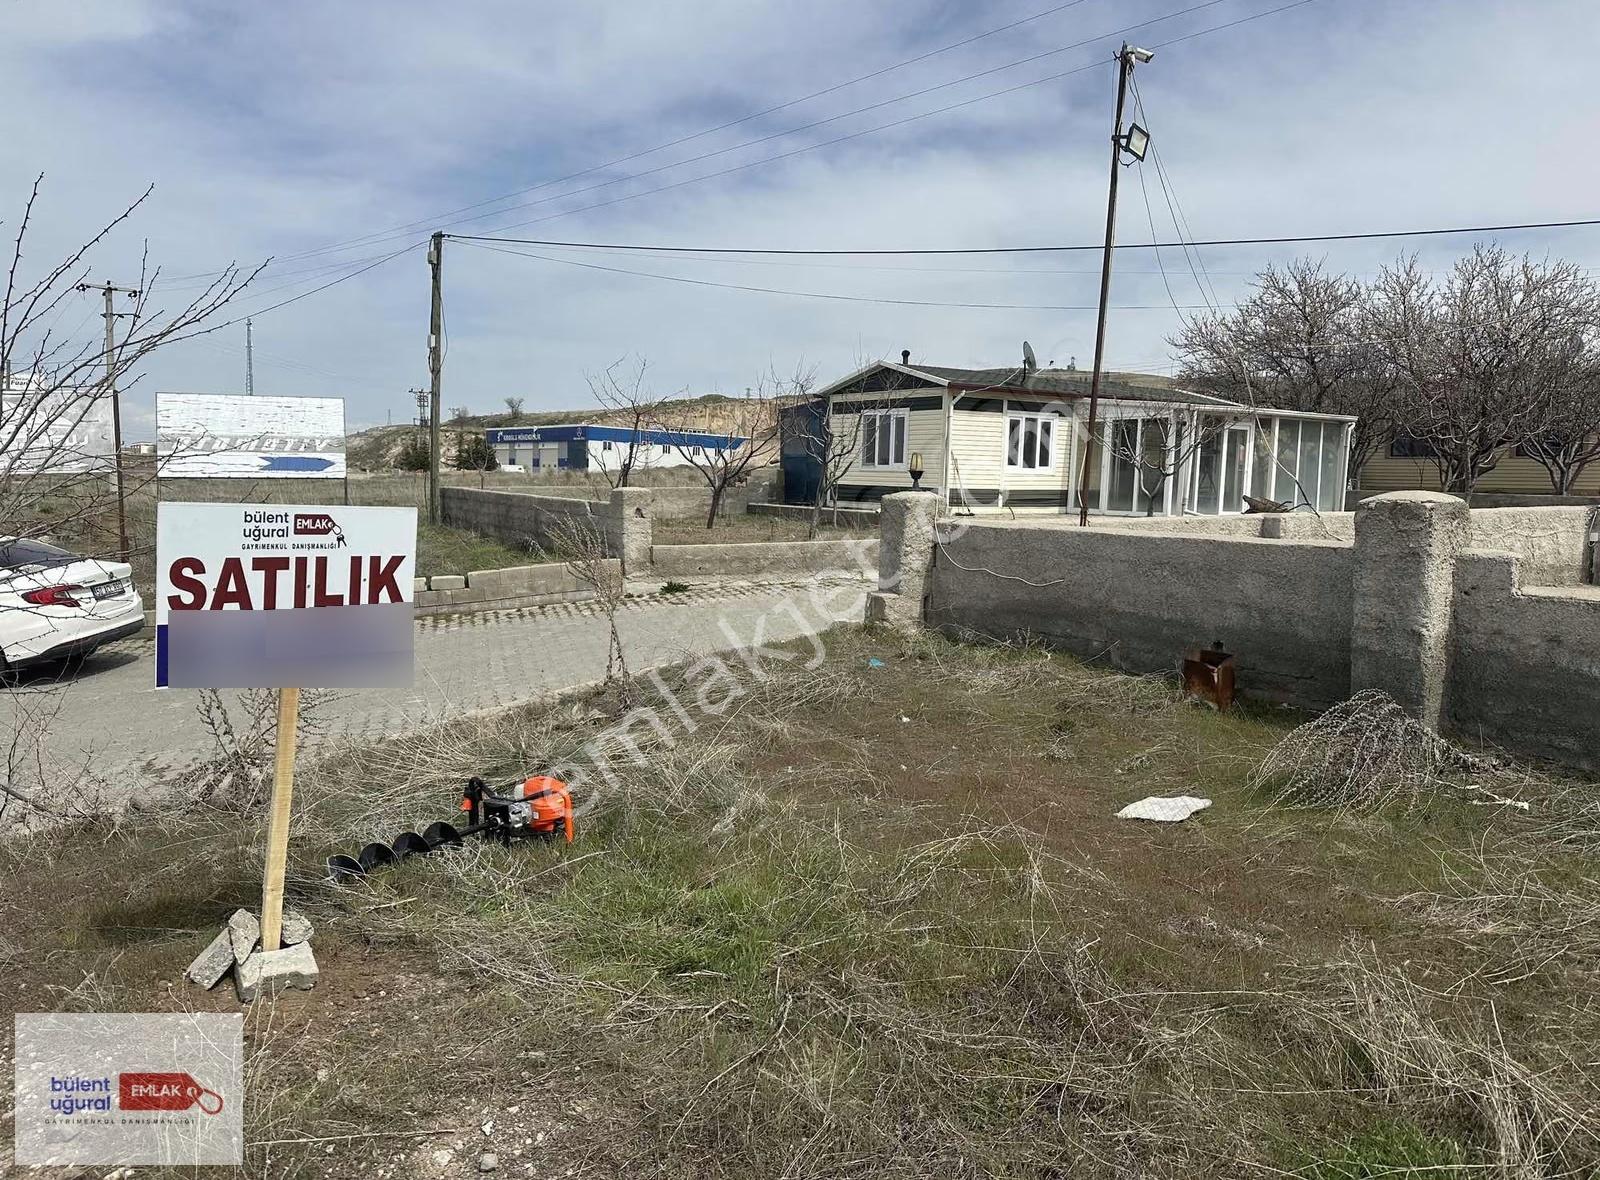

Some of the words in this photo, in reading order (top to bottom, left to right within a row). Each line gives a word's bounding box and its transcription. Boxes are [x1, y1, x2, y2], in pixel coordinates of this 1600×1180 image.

[244, 511, 289, 523] bülent
[296, 518, 329, 529] EMLAK
[243, 525, 289, 541] uğural
[167, 555, 407, 610] SATILIK
